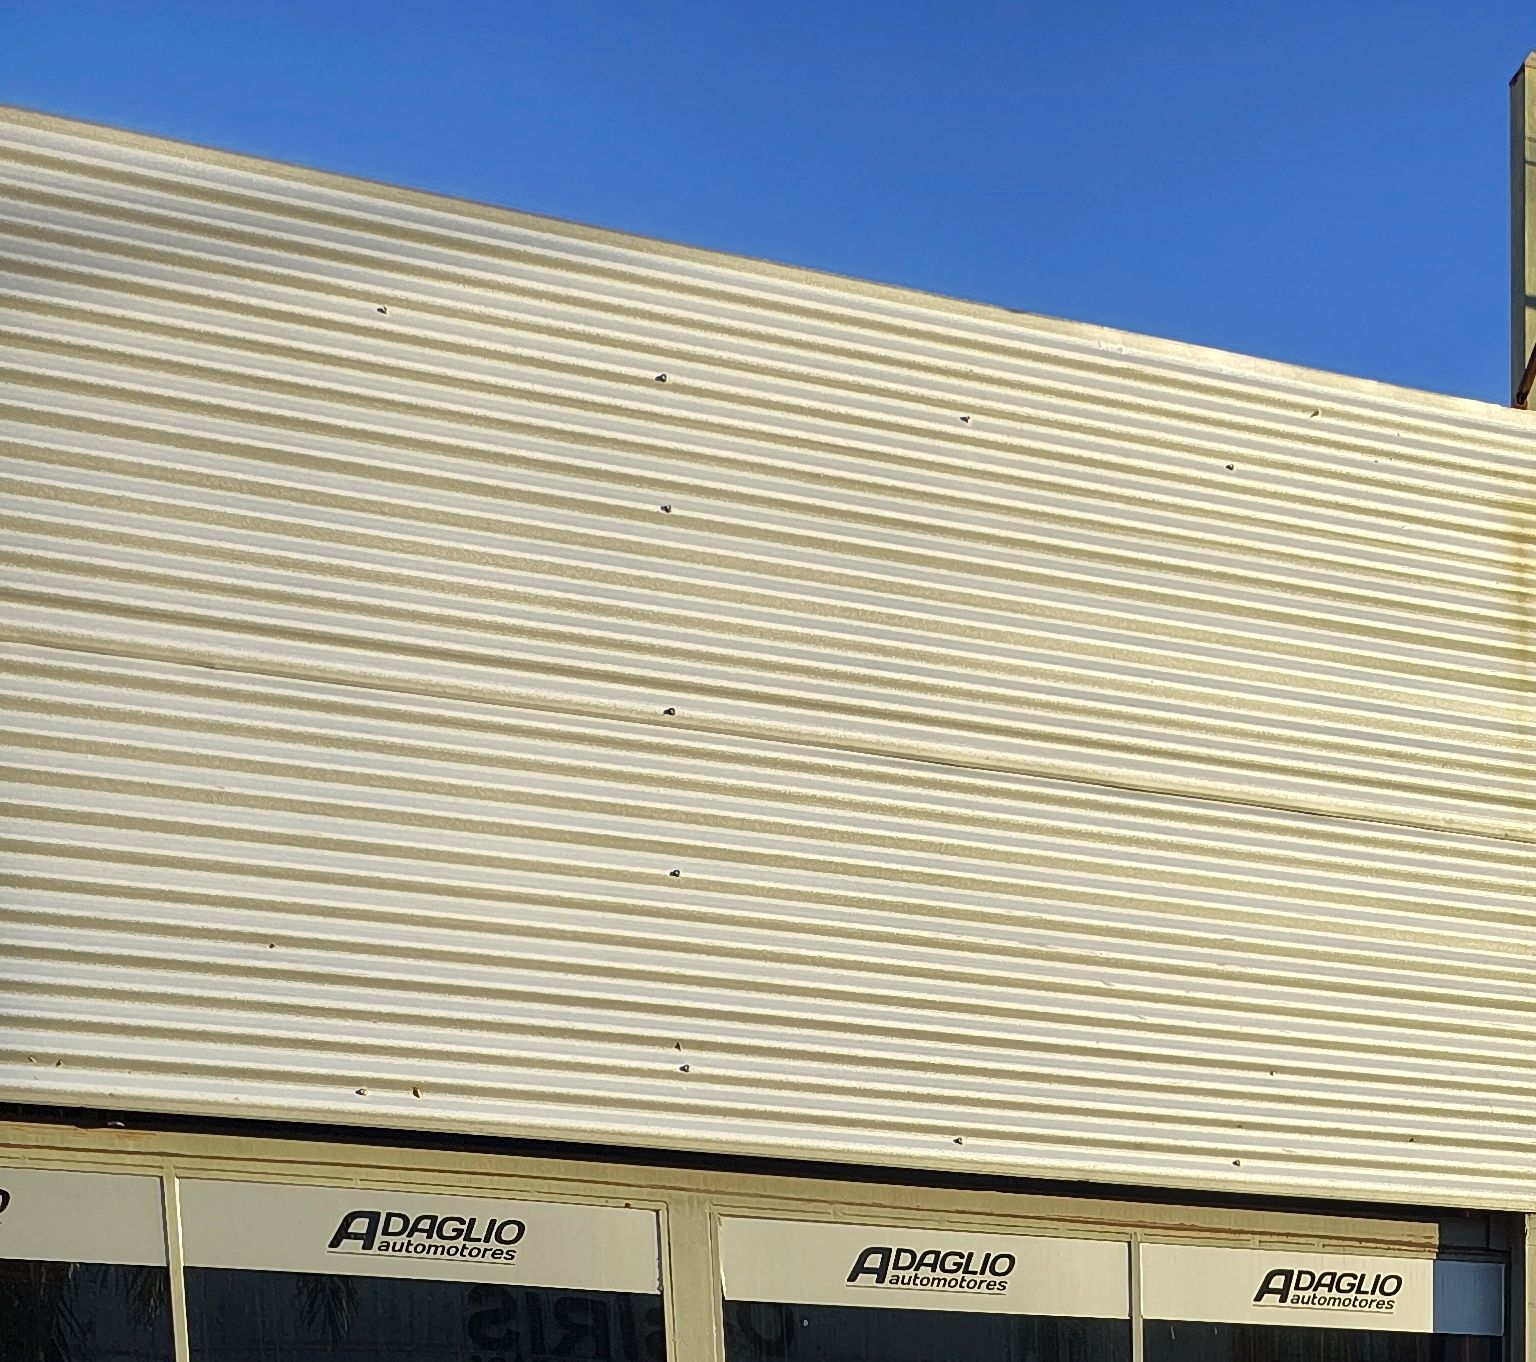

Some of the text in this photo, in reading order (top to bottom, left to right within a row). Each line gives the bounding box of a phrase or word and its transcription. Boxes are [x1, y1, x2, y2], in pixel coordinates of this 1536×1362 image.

[328, 1210, 526, 1251] ADAGLIO
[377, 1239, 516, 1262] automotores
[847, 1246, 1016, 1284] ADAGLIO
[888, 1273, 1008, 1291] automotores
[1253, 1268, 1403, 1303] ADAGLIO
[1290, 1293, 1396, 1310] automotores
